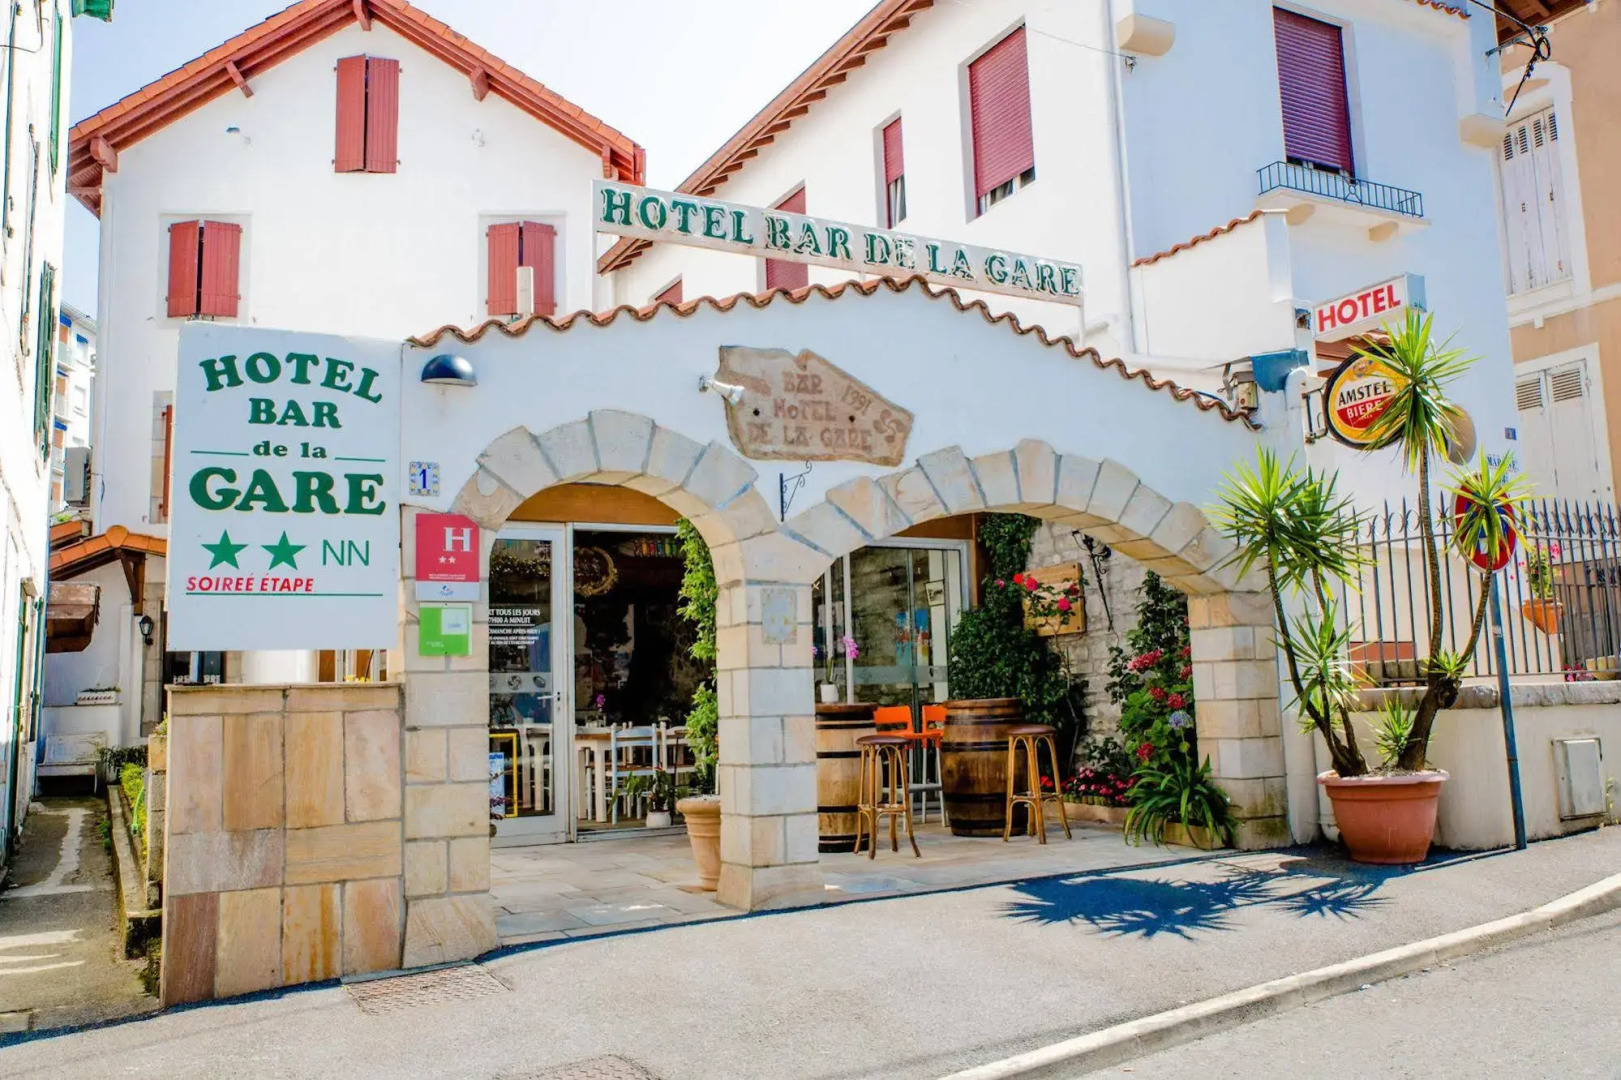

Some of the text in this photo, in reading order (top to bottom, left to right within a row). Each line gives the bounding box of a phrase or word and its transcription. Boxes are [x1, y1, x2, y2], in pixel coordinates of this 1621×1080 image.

[600, 187, 1083, 297] HOTEL BAR DE LA GARE
[1317, 284, 1401, 332] HOTEL
[199, 352, 383, 403] HOTEL
[782, 372, 823, 394] BAR
[1338, 380, 1391, 407] AMSTEL
[248, 398, 342, 429] BAR
[253, 441, 328, 459] de la
[748, 423, 873, 452] DE LA GARE
[189, 466, 387, 516] GARE
[418, 468, 428, 490] 1
[322, 539, 370, 566] NN
[442, 526, 474, 553] H
[186, 572, 315, 593] SOIREÉ ÉTAPE
[496, 608, 511, 617] TOUS
[512, 608, 522, 617] LES
[522, 608, 541, 618] JOURS
[509, 616, 531, 624] MINUIT
